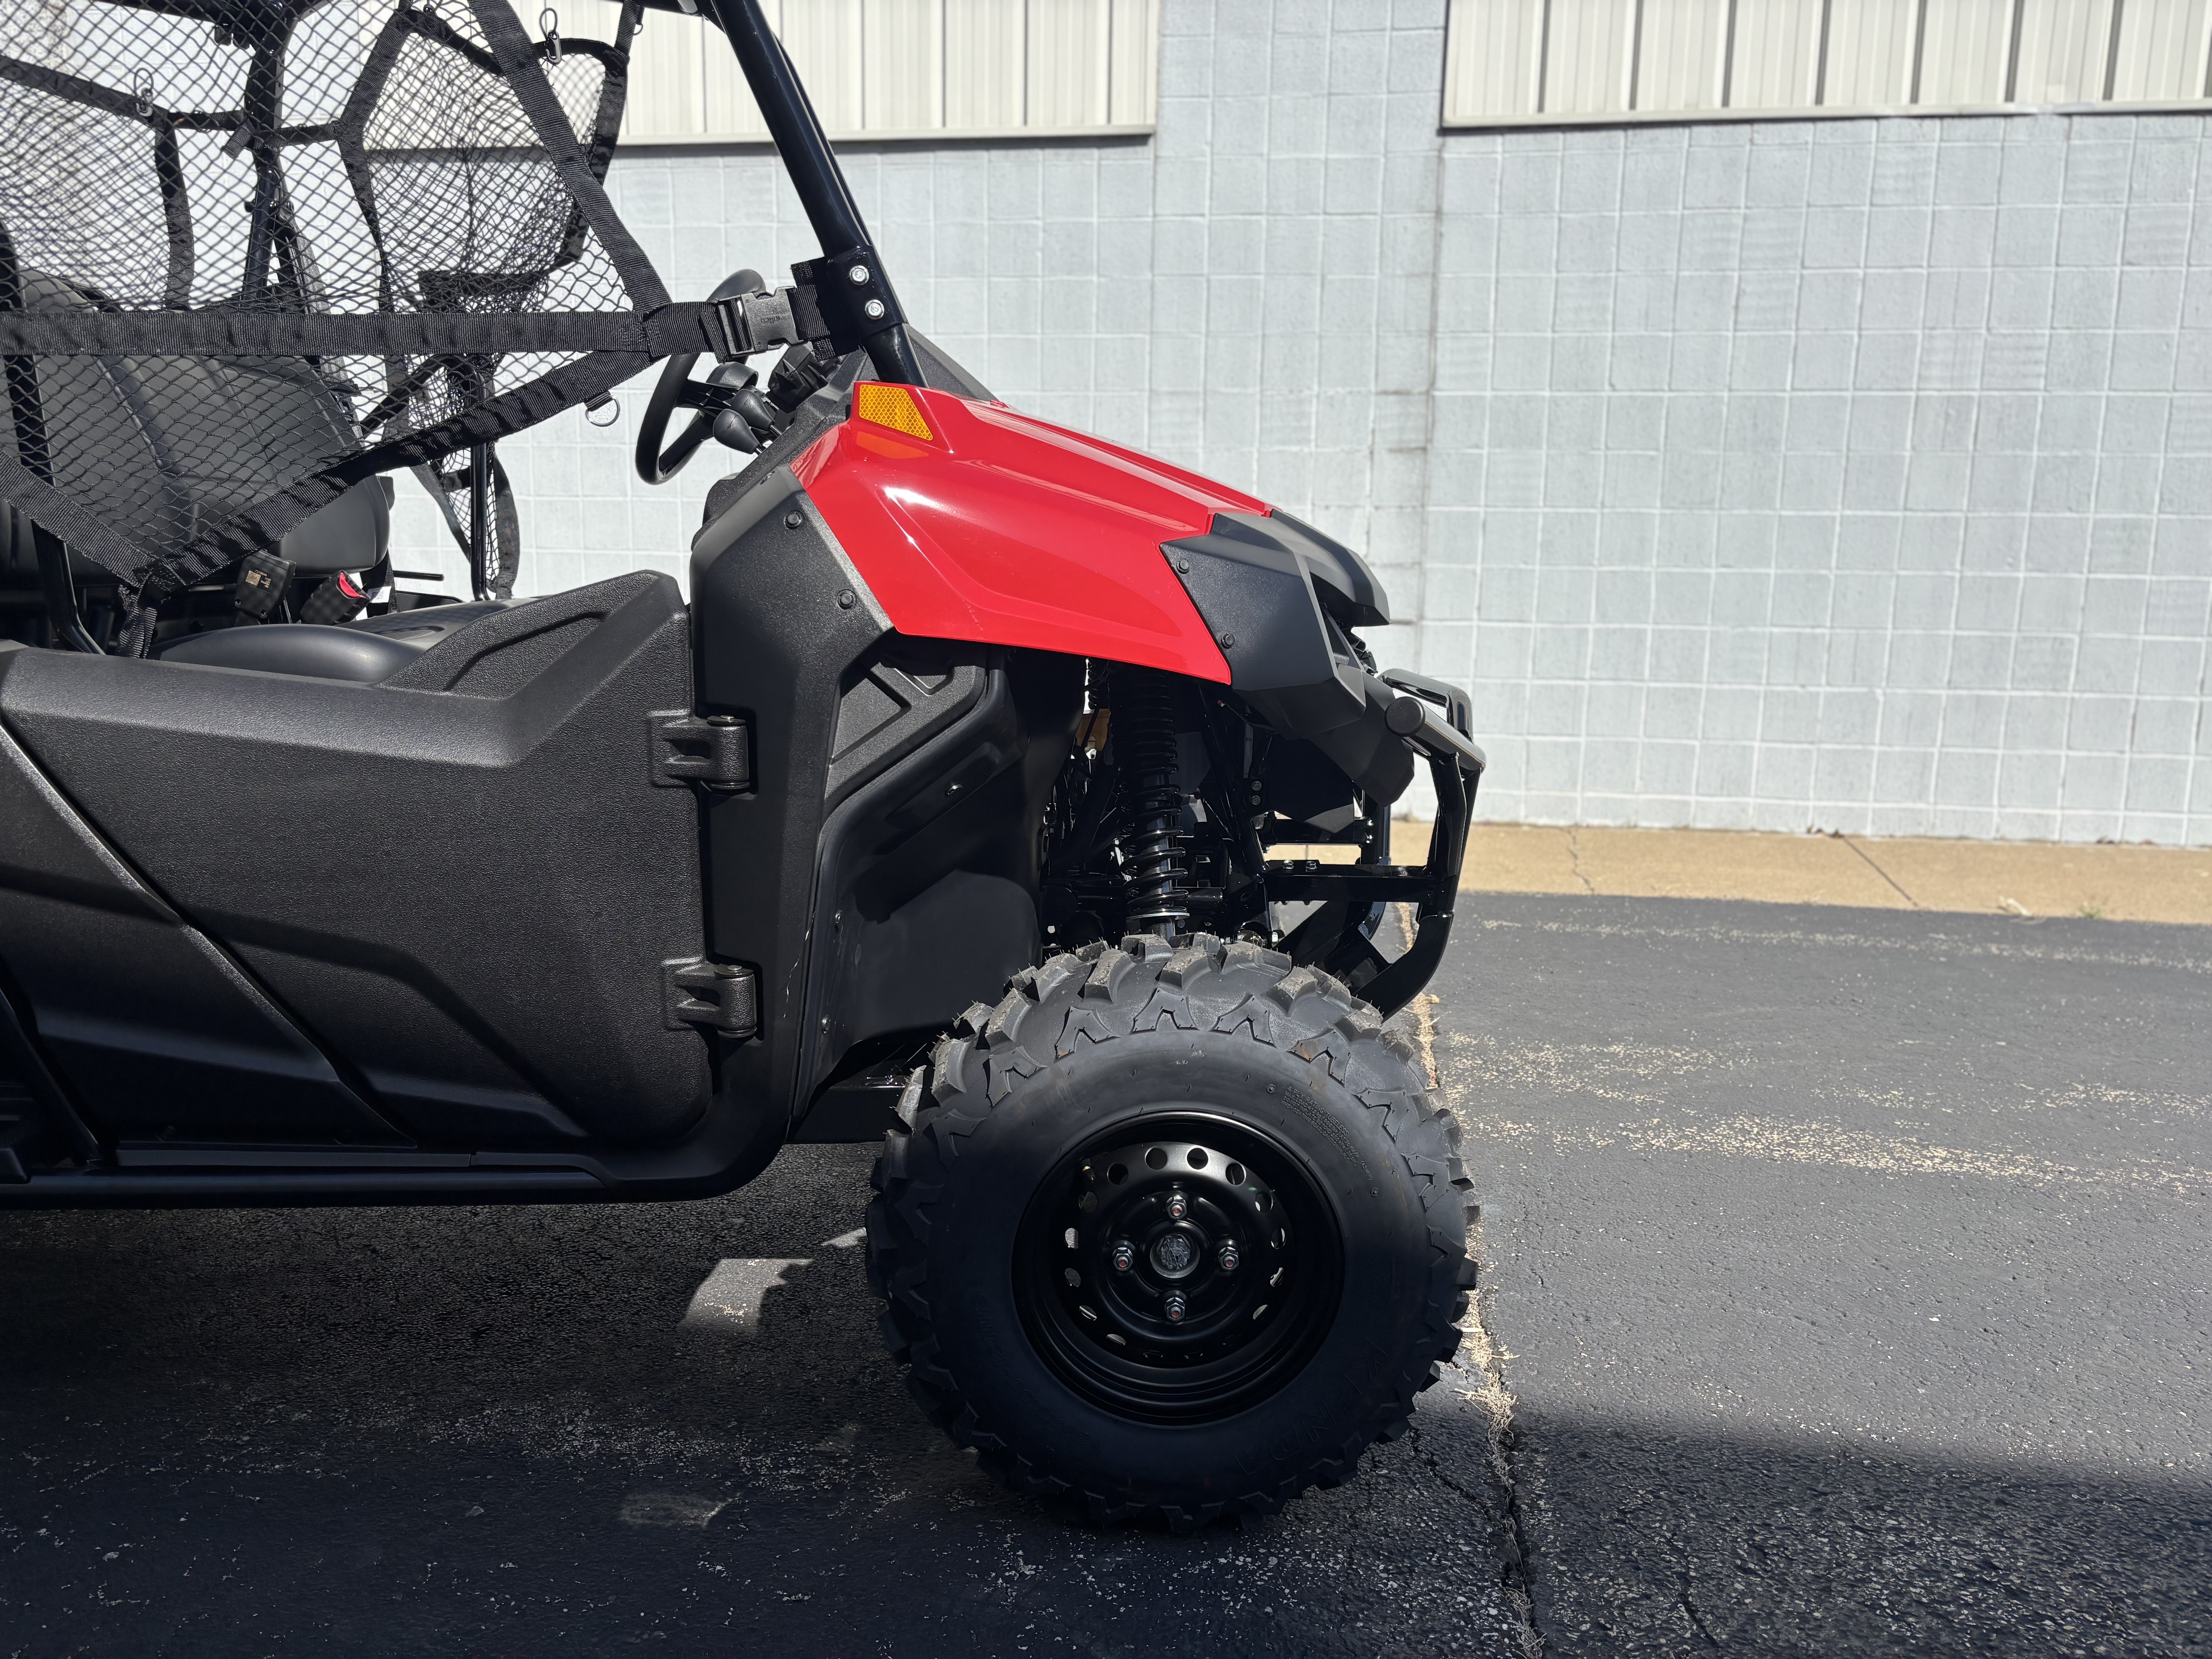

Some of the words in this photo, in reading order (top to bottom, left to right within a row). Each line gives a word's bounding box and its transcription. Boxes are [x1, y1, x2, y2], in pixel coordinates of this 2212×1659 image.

[1292, 1089, 1305, 1099] PLY
[1305, 1096, 1325, 1113] RATING
[1324, 1111, 1349, 1136] TUBELESS
[1231, 1338, 1392, 1477] KENDA
